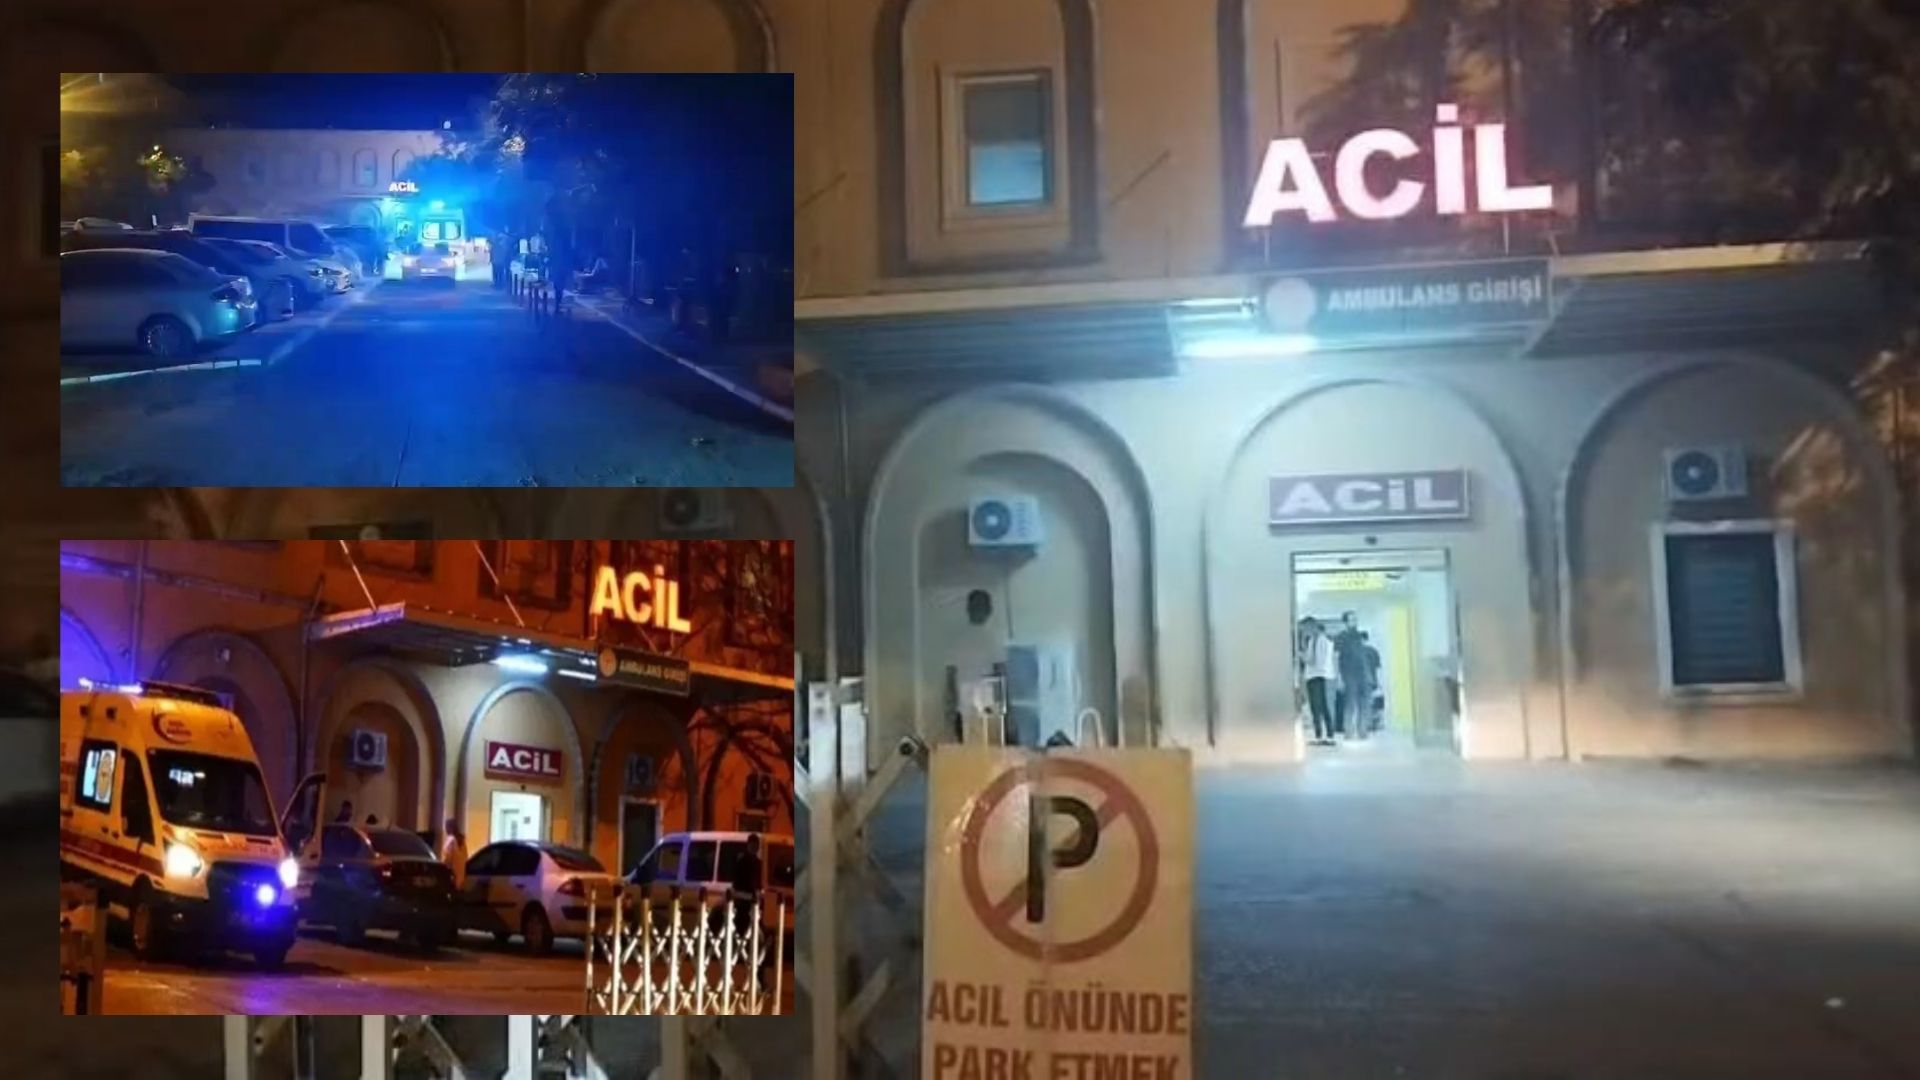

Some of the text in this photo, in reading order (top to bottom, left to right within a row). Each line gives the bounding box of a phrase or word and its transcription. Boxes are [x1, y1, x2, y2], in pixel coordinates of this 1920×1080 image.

[1243, 103, 1553, 227] ACİL
[1328, 284, 1460, 312] AMBULANS
[589, 564, 692, 634] ACİL
[1026, 795, 1098, 923] P
[1024, 979, 1188, 1035] ÖNÜNDE
[934, 1043, 1032, 1080] PARK
